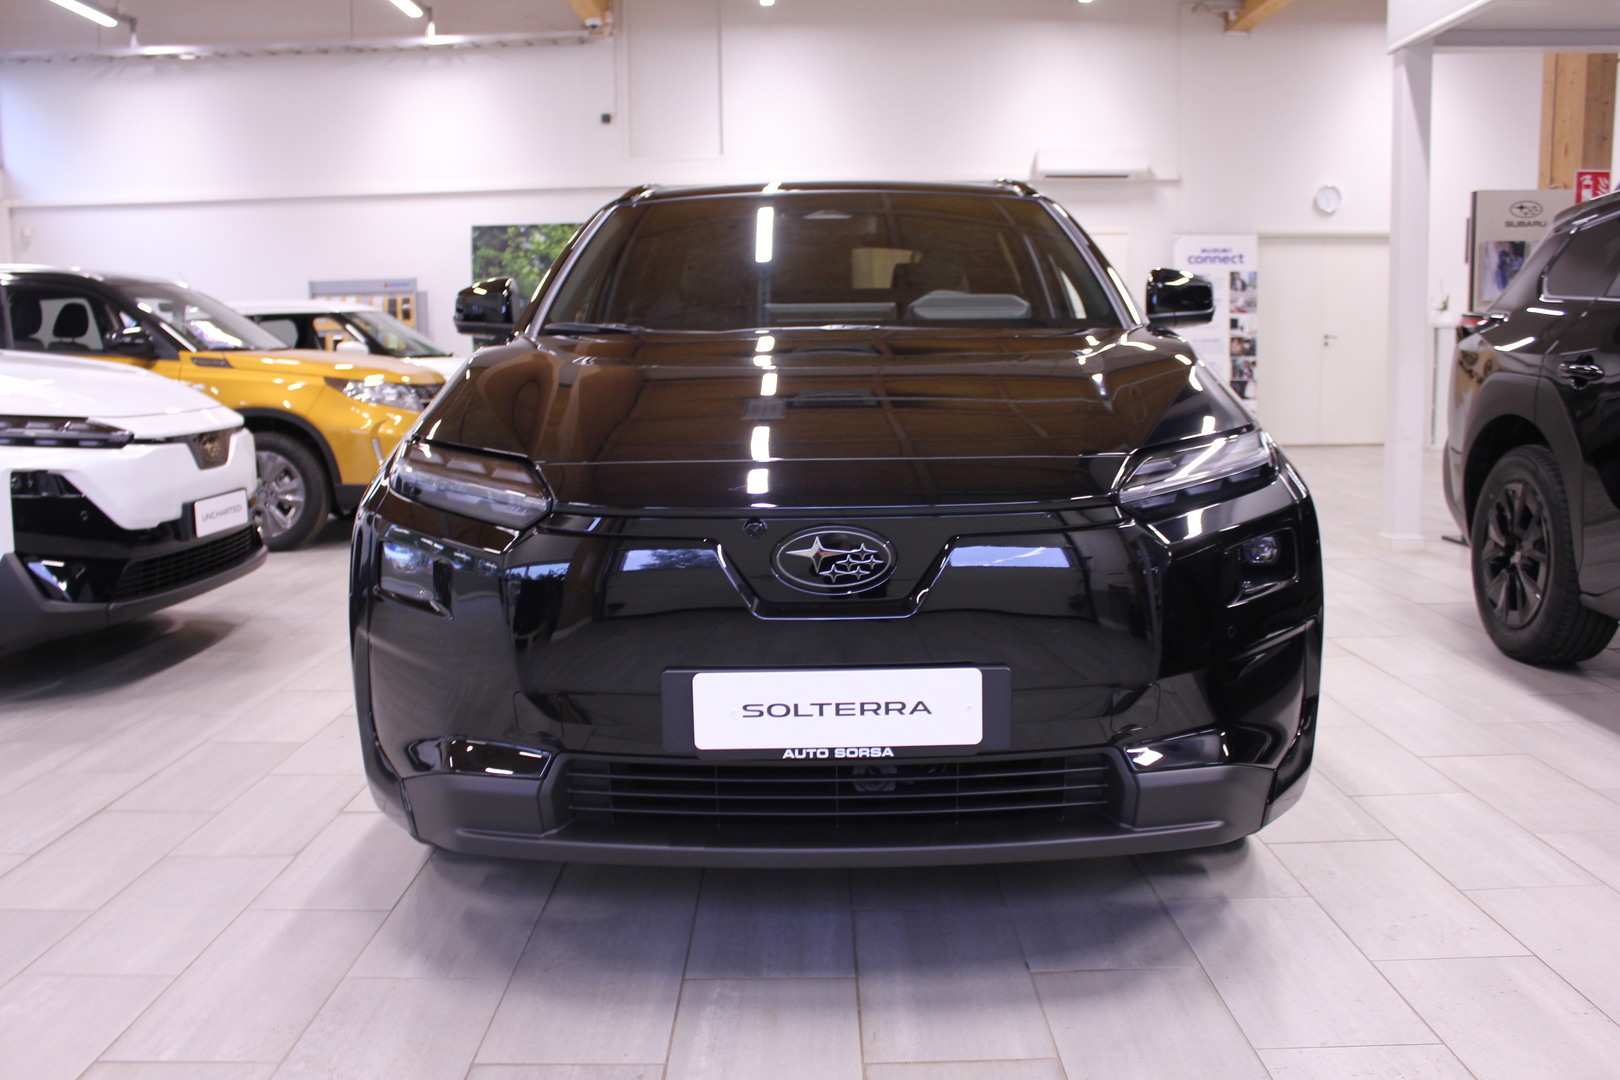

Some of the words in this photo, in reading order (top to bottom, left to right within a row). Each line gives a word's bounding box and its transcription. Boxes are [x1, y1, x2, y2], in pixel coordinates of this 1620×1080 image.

[1187, 254, 1244, 265] connect
[201, 504, 242, 522] UNCHARTED
[742, 701, 932, 718] SOLTERRA
[782, 749, 829, 760] AUTO
[834, 747, 894, 759] SORSA
